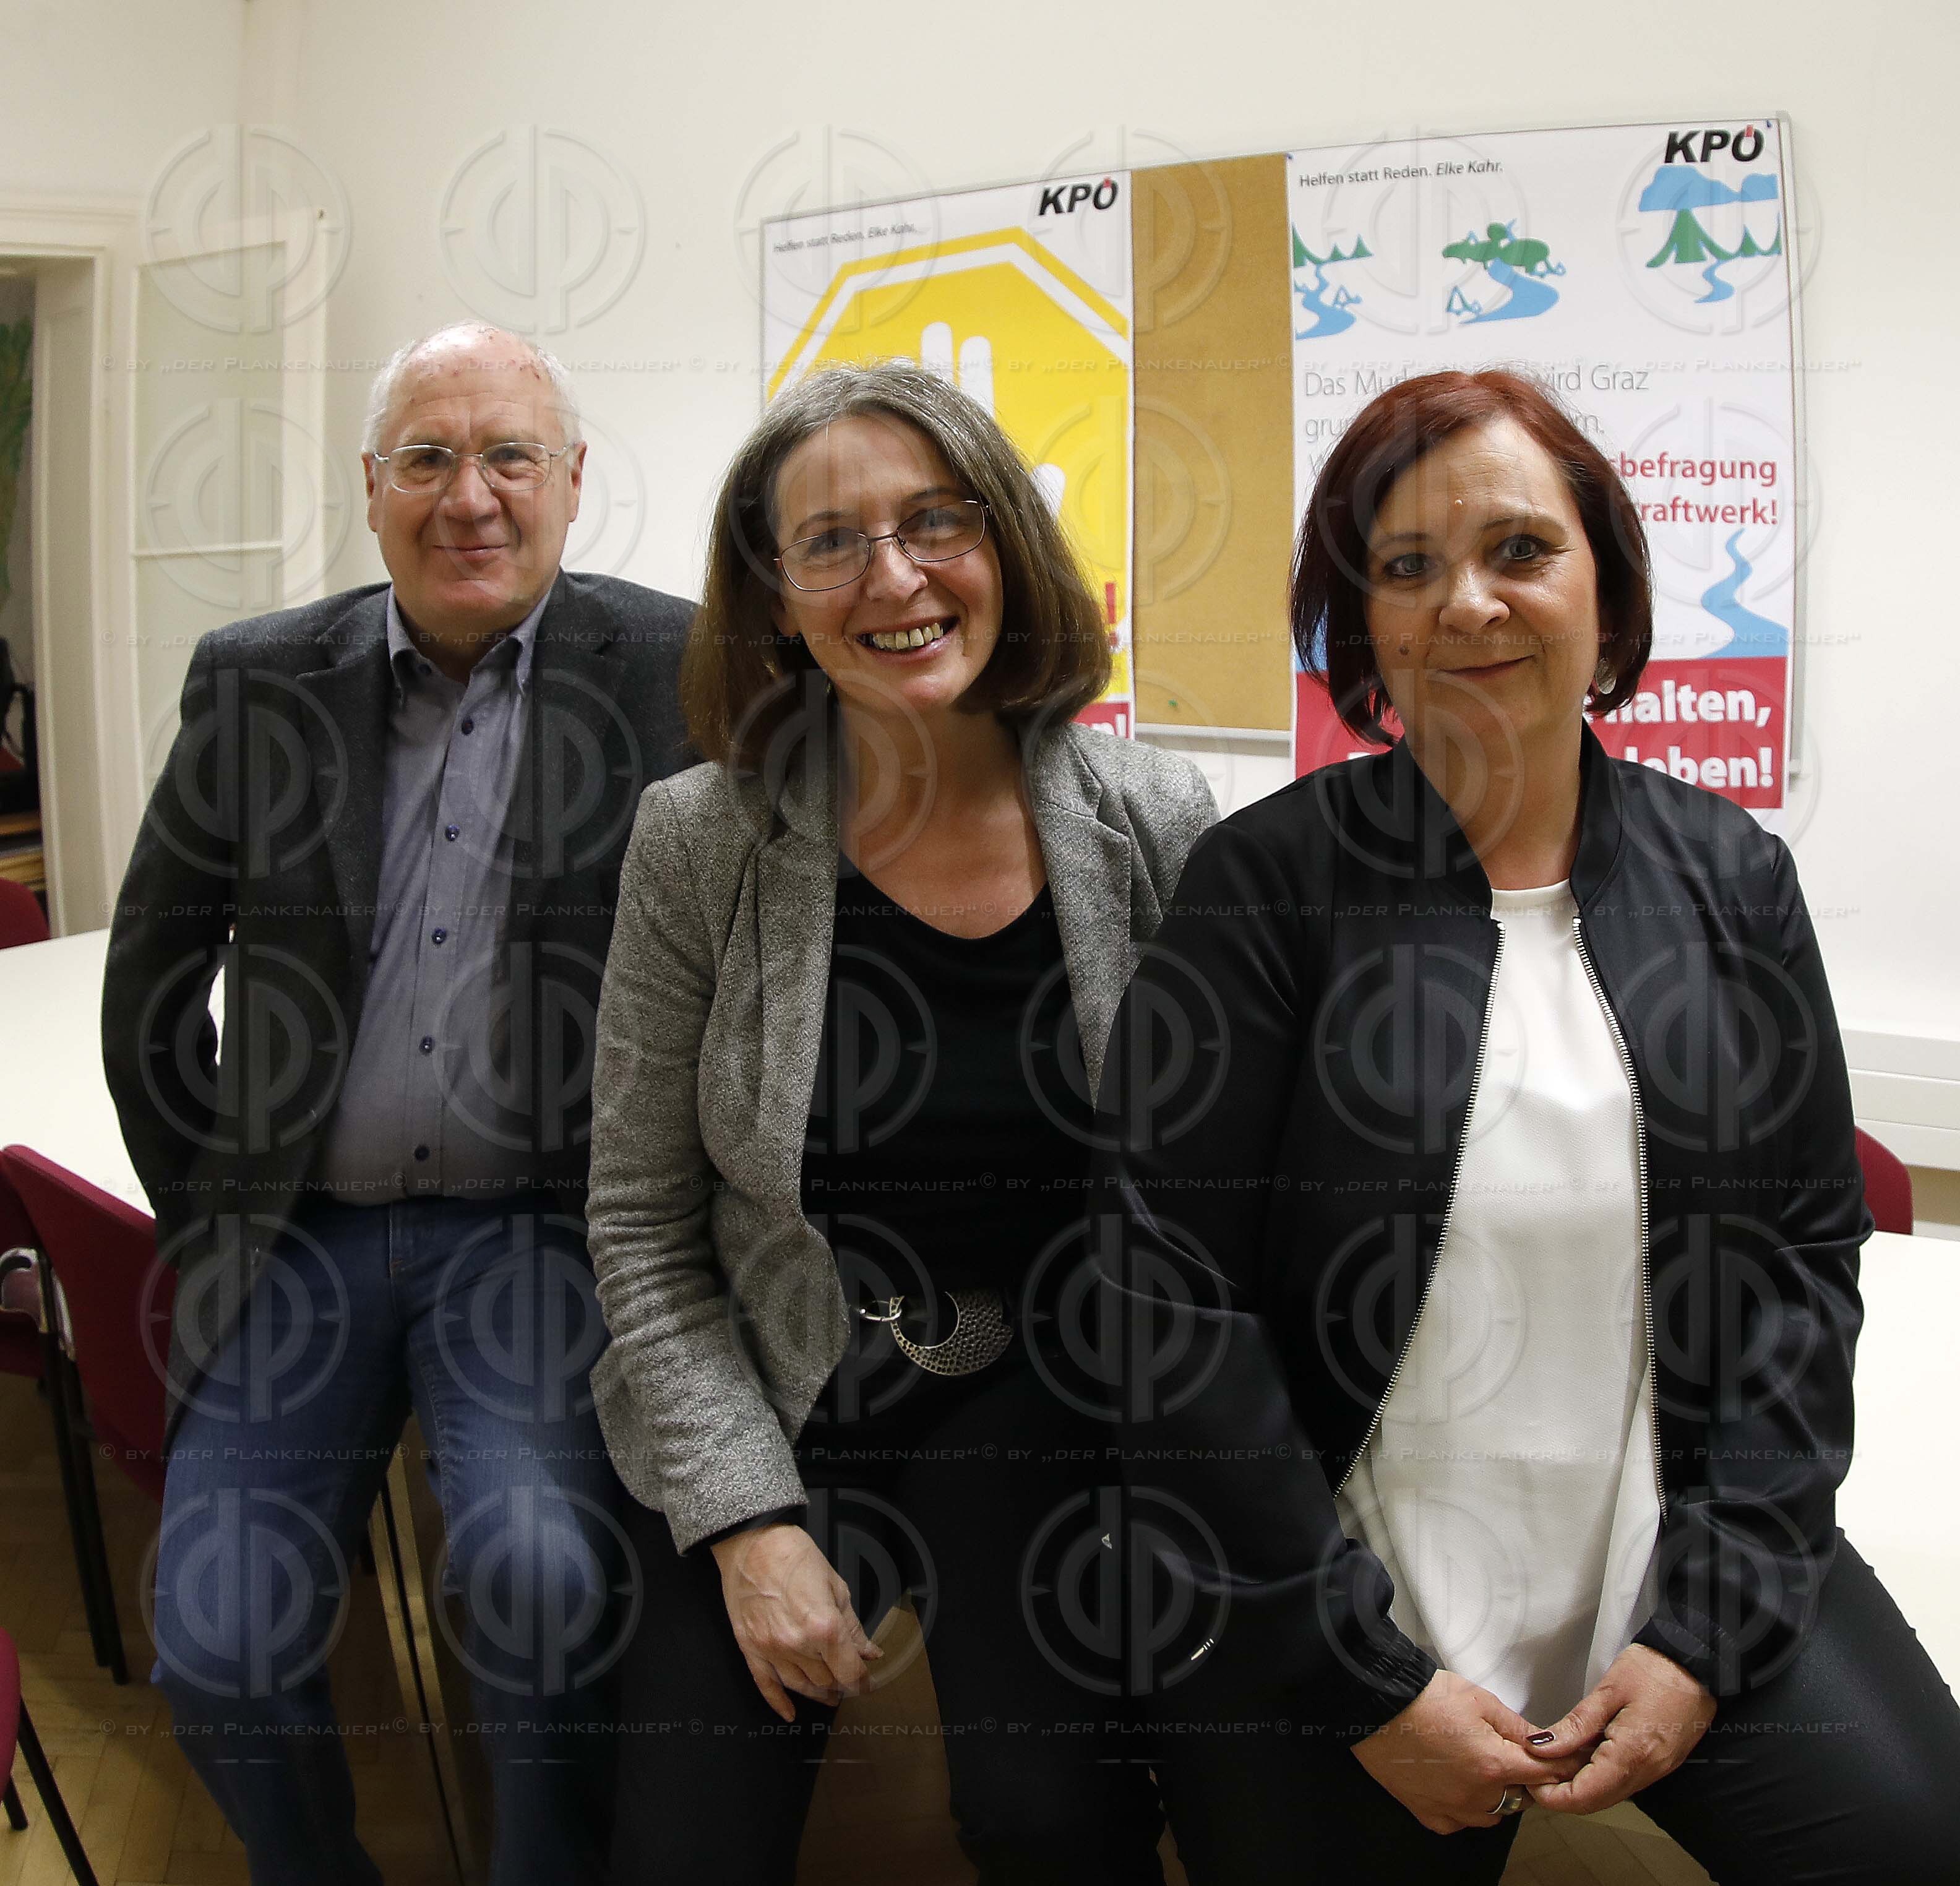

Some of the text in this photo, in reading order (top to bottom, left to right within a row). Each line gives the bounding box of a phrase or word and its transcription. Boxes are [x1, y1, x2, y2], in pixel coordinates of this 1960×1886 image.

[1300, 158, 1503, 187] Helfen statt Reden. Elke Kahr.
[1305, 372, 1346, 396] Das
[1591, 364, 1649, 390] Graz
[1640, 495, 1778, 525] raftwerk!
